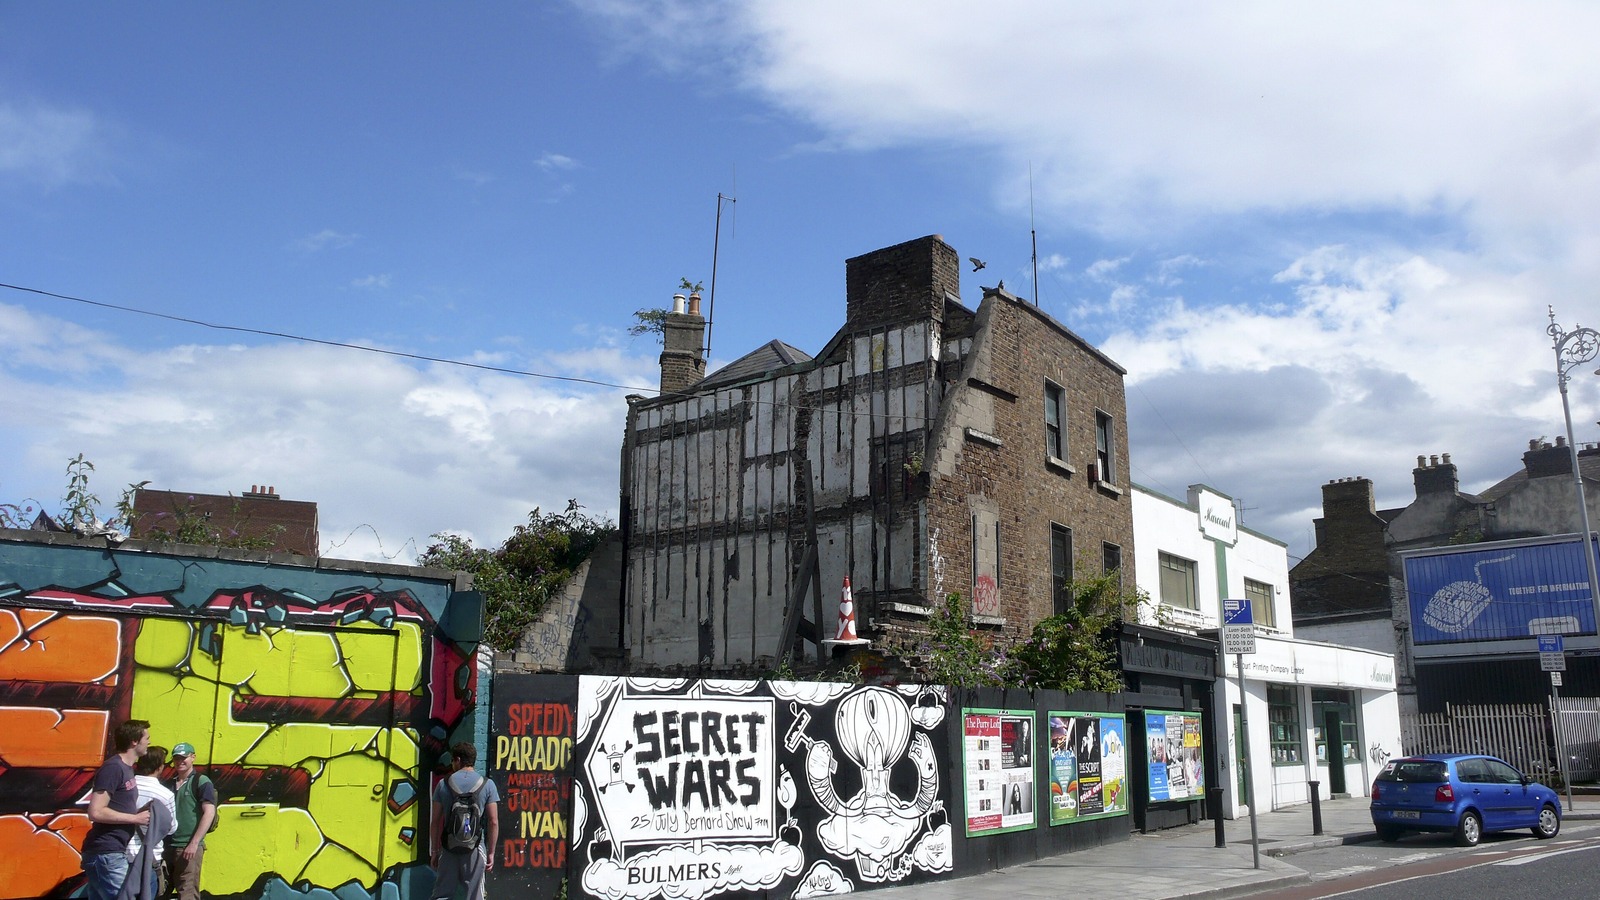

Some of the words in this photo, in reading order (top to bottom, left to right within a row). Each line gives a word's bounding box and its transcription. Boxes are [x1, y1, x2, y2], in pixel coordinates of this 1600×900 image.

[1253, 663, 1269, 673] Printing
[1270, 664, 1289, 674] Company
[508, 703, 574, 736] SPEEDY
[966, 717, 976, 728] The
[633, 711, 766, 764] SECRET
[638, 759, 761, 811] WARS
[684, 810, 723, 834] Bernard
[725, 811, 753, 831] Shaw
[504, 839, 526, 868] DJ
[628, 863, 721, 885] BULMERS
